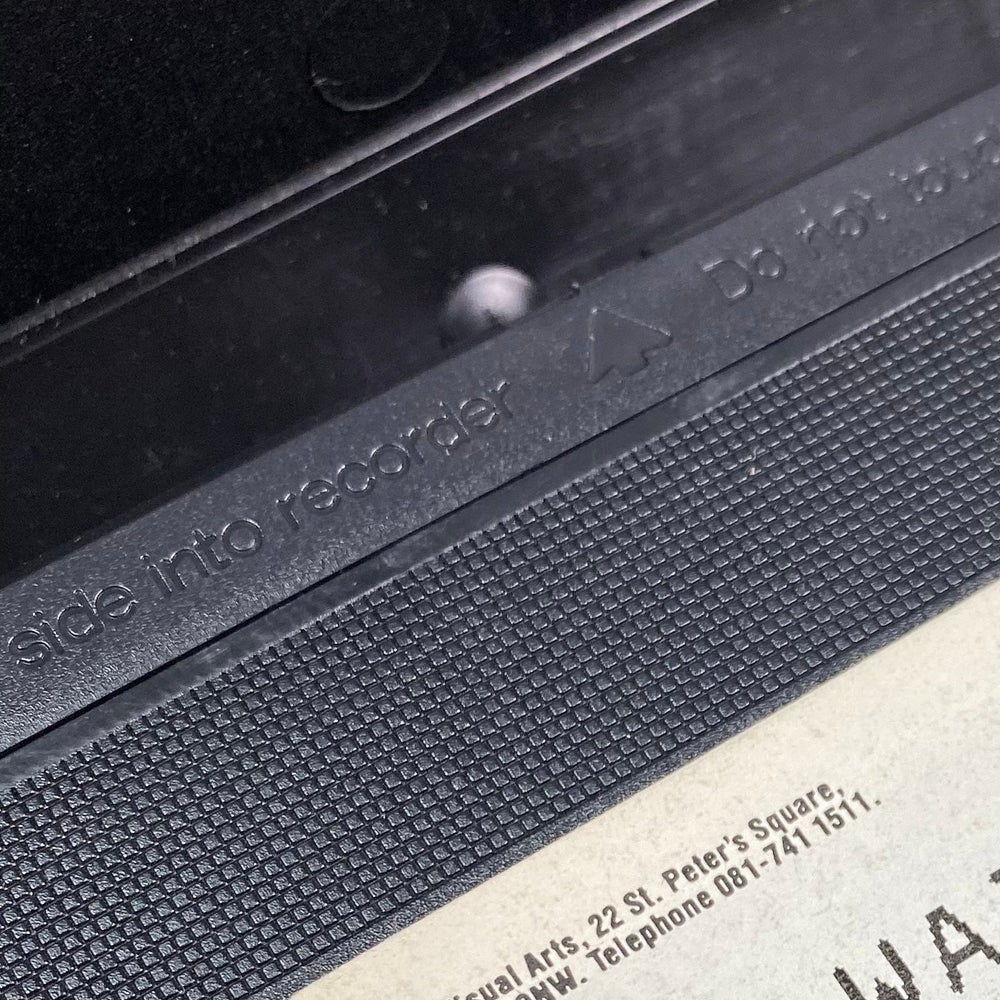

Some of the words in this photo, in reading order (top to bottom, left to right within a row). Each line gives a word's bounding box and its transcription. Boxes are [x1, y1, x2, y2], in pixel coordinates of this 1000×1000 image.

[7, 584, 139, 668] side
[140, 517, 266, 597] into
[276, 380, 513, 530] recorder
[523, 935, 590, 979] Arts,
[587, 904, 625, 939] 22
[622, 886, 664, 916] St.
[661, 834, 750, 894] Peter's
[747, 783, 845, 841] Square,
[584, 890, 715, 972] Telephone
[713, 827, 812, 898] 081-741
[811, 791, 882, 837] 1511.
